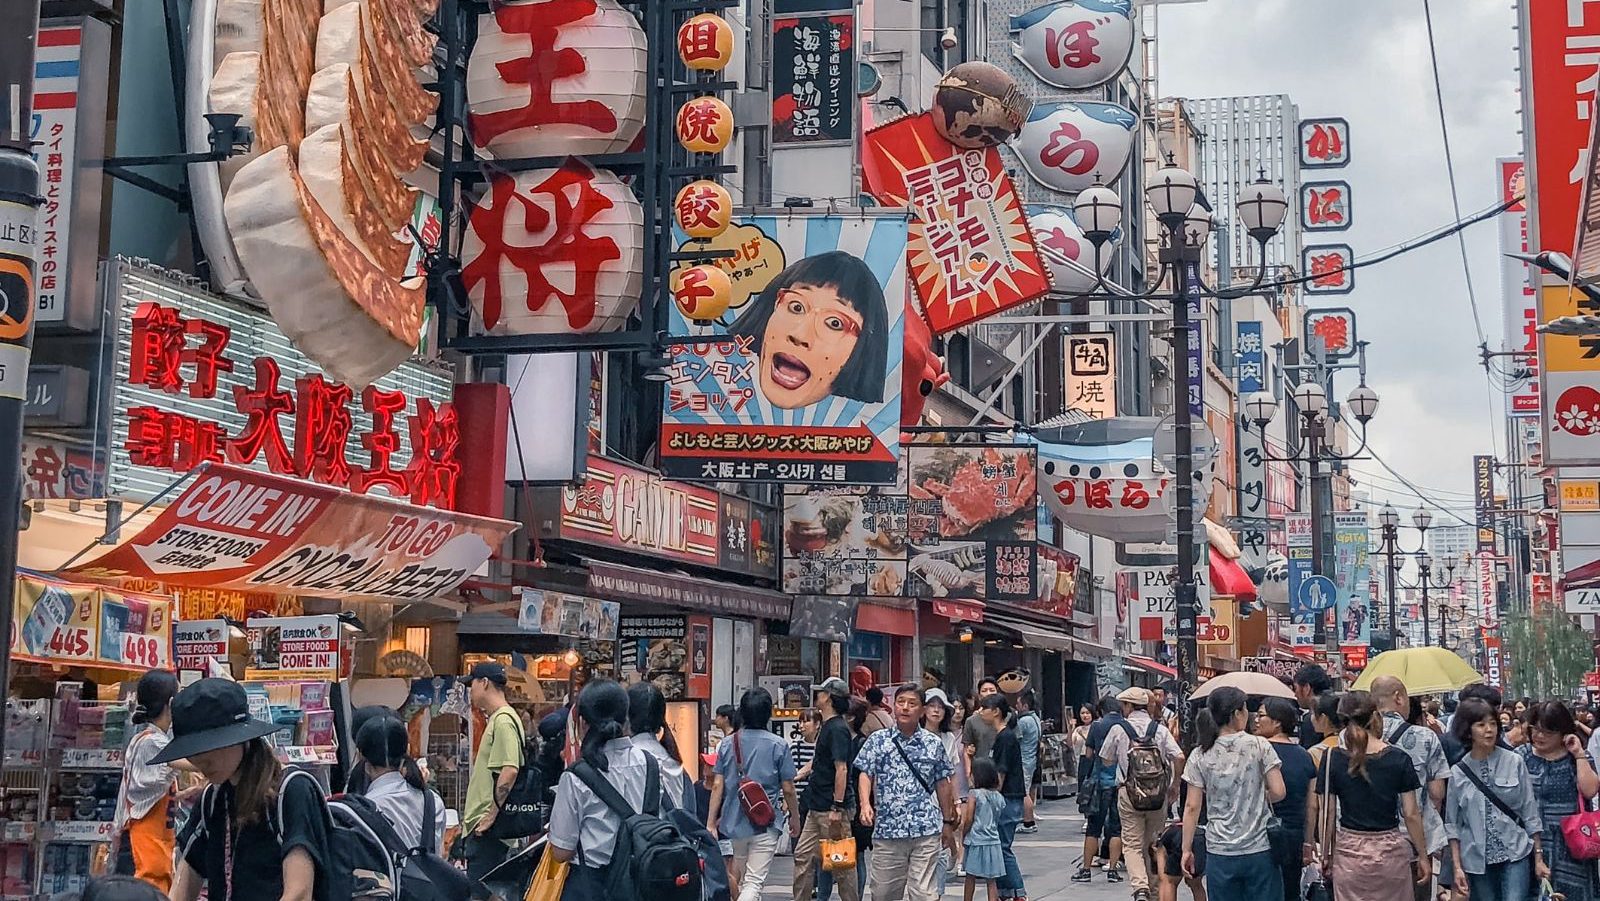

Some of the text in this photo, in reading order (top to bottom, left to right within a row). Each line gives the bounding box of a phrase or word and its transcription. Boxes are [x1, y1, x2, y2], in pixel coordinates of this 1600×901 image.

[460, 0, 621, 330] 王将
[41, 123, 63, 290] タイ料理とタイスキの店
[906, 168, 975, 300] ミュージアム
[39, 295, 55, 310] B1
[130, 302, 234, 398] 餃子
[1075, 346, 1105, 368] 牛角
[670, 361, 755, 385] エンタメ
[669, 388, 755, 414] ショップ
[226, 357, 461, 511] 大阪王将
[669, 432, 872, 452] よしもと芸人グッズ・大阪みやげ
[820, 463, 847, 481] 선물
[177, 475, 321, 537] COME IN!
[616, 475, 687, 552] GAME
[158, 528, 263, 559] STORE FOODS
[376, 514, 457, 559] TO GO
[252, 547, 384, 591] GYOZA
[382, 560, 467, 599] BEER
[1143, 571, 1206, 586] PAA
[50, 626, 89, 656] 445
[177, 630, 205, 641] 内飲食OK
[193, 643, 218, 653] FOODS
[282, 641, 330, 652] STORE FOODS
[125, 635, 159, 667] 498
[175, 655, 198, 669] OME
[281, 653, 330, 669] COME IN!
